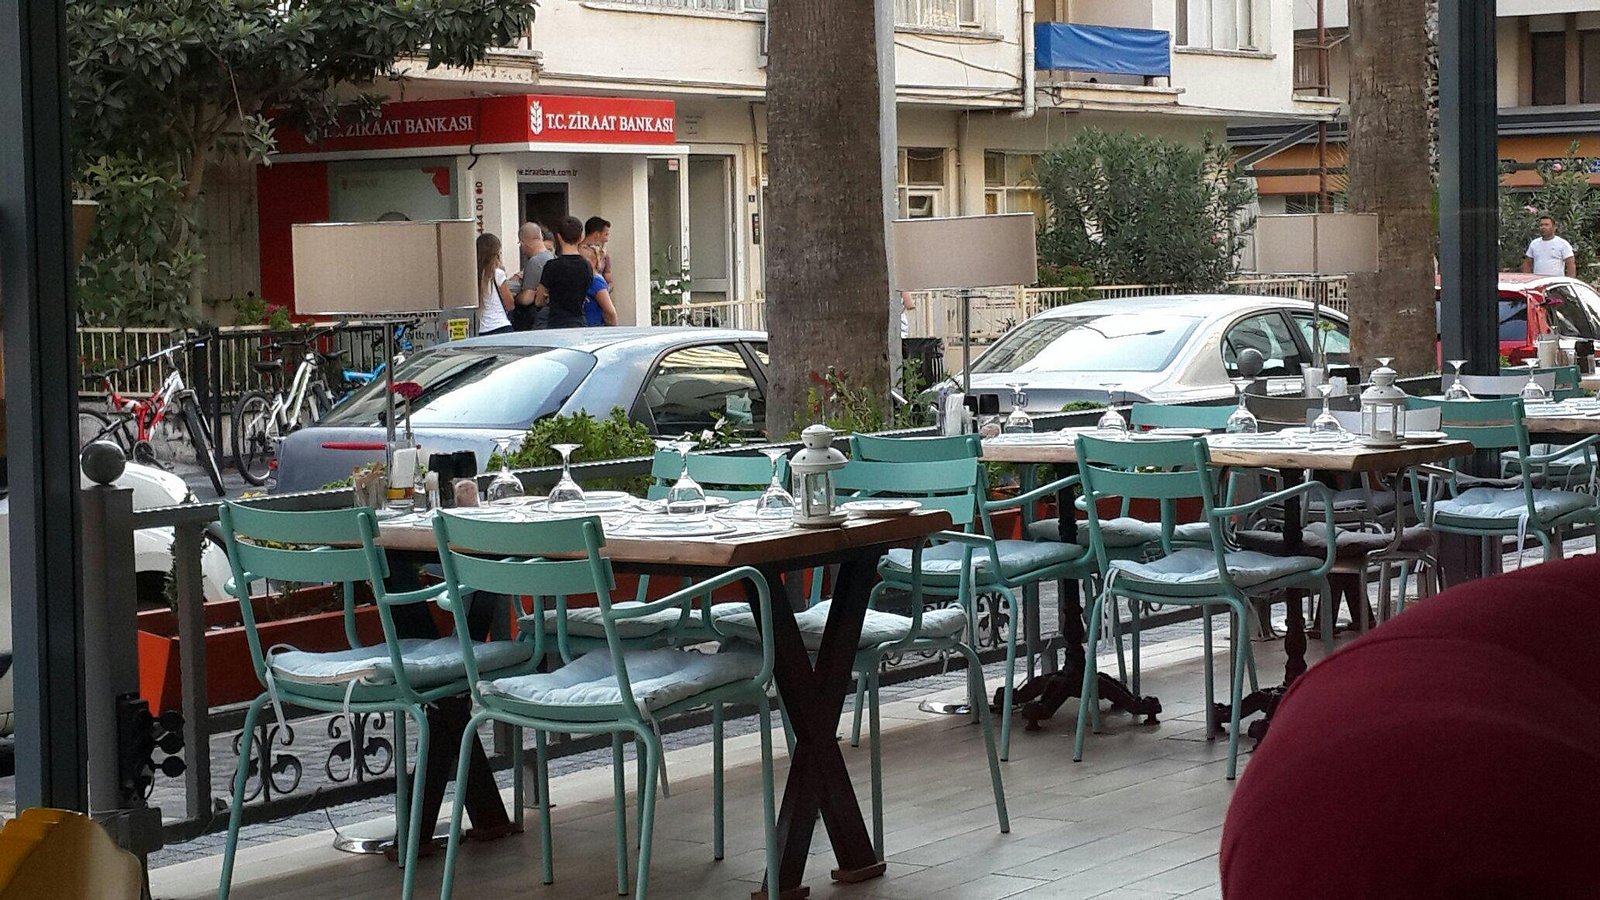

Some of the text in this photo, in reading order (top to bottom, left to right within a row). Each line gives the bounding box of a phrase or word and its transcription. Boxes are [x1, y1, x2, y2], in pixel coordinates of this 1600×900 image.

[405, 115, 473, 135] BANKASI
[546, 113, 567, 130] T.C.
[619, 116, 673, 133] BANKASI
